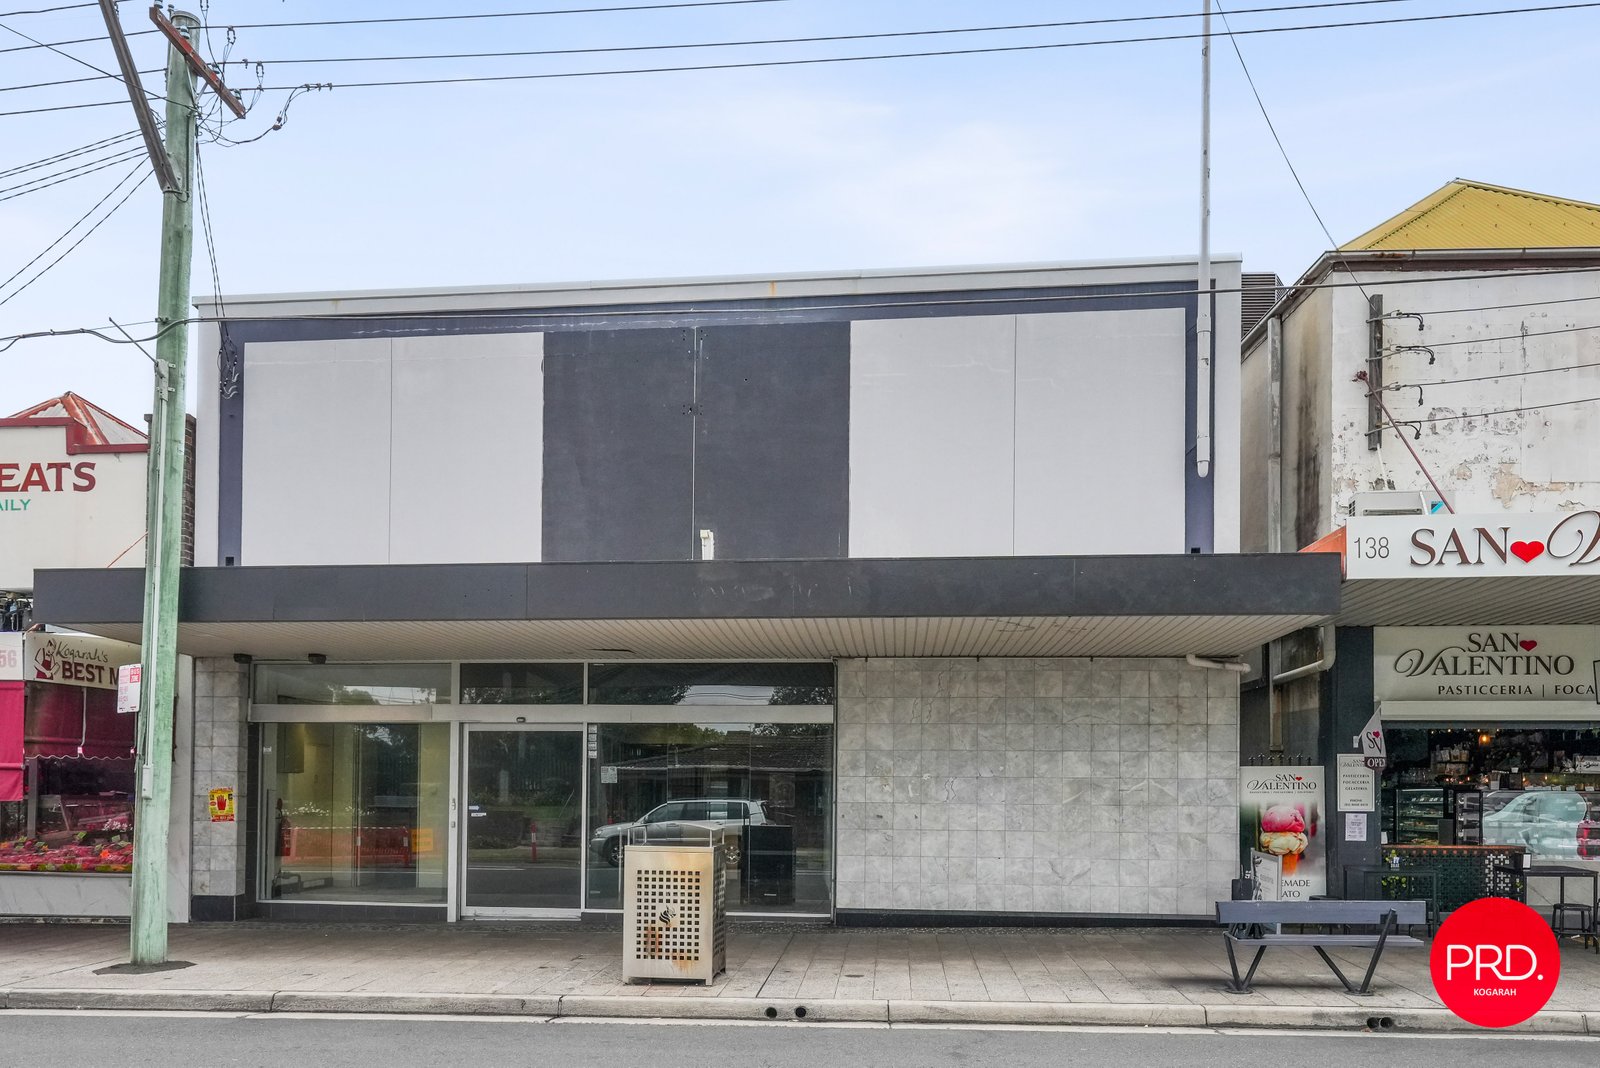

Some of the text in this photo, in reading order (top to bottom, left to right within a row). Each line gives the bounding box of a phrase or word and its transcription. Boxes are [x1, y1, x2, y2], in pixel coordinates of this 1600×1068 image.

[0, 461, 96, 492] EATS
[1353, 536, 1390, 559] 138
[1410, 526, 1511, 567] SAN
[1467, 632, 1520, 653] SAN
[61, 660, 105, 684] BEST
[1393, 646, 1575, 677] VALENTINO
[1438, 685, 1533, 695] PASTICCERIA
[1246, 778, 1317, 790] VALENTINO
[1275, 773, 1296, 782] SAN
